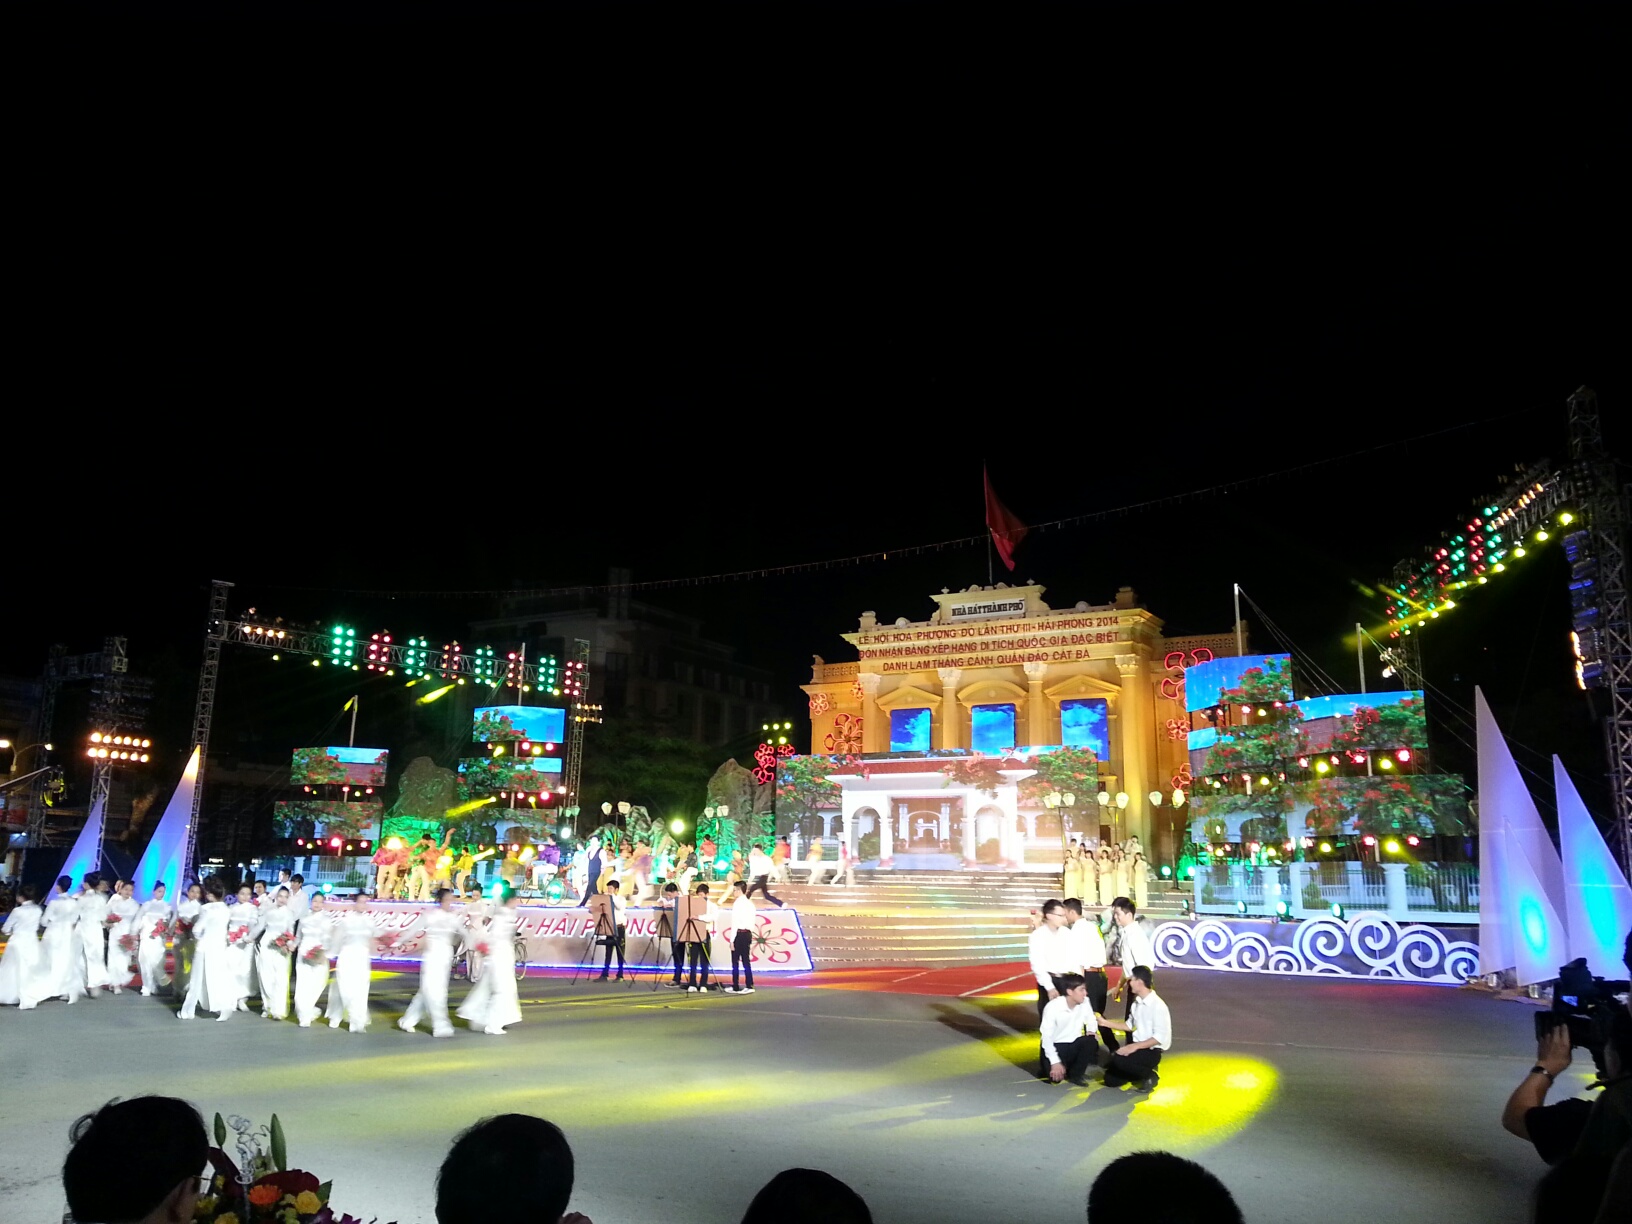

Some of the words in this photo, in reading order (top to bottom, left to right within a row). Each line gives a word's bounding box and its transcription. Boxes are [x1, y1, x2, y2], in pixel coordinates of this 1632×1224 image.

[951, 605, 967, 616] NHÀ
[967, 604, 982, 615] HÁT
[981, 602, 1008, 614] THÀNH
[893, 632, 912, 642] HOA
[1023, 623, 1031, 632] III
[1058, 616, 1093, 629] PHÒNG
[1096, 616, 1119, 627] 2014
[980, 641, 989, 651] DI
[1049, 635, 1068, 646] GIA
[883, 662, 908, 671] DANH
[910, 660, 930, 670] LAM
[535, 912, 579, 935] HẢI
[580, 917, 659, 936] PNG
